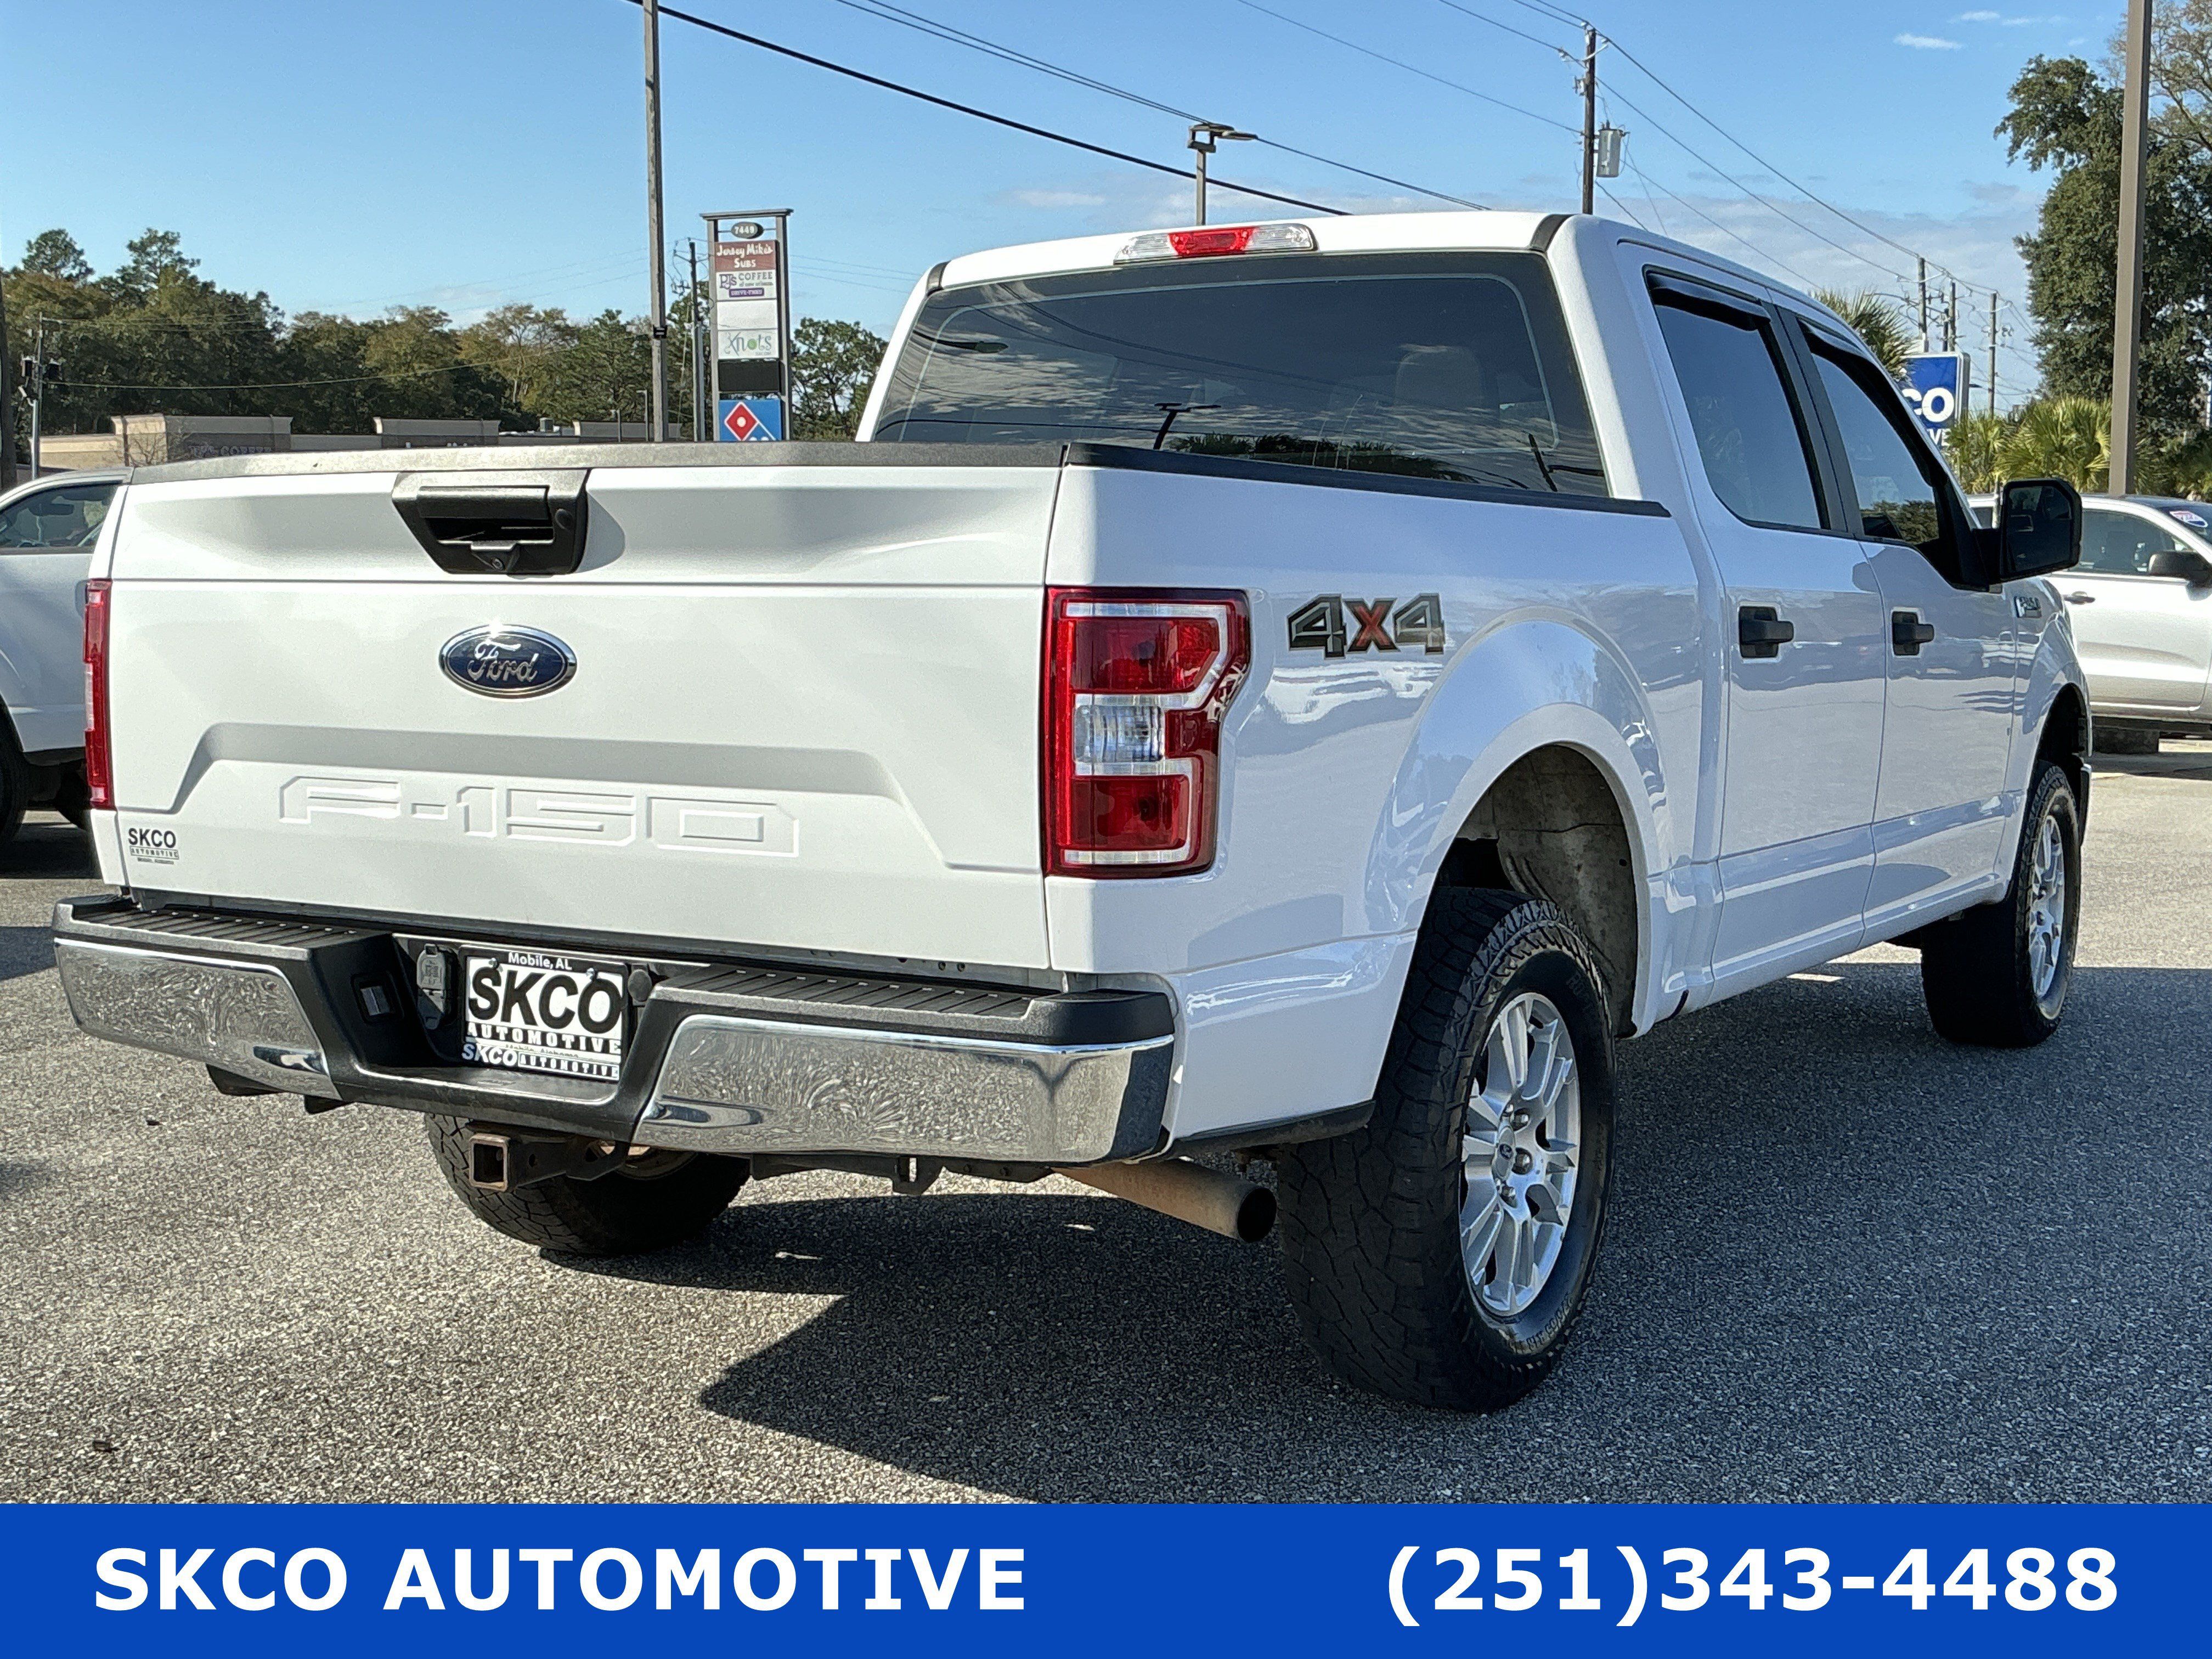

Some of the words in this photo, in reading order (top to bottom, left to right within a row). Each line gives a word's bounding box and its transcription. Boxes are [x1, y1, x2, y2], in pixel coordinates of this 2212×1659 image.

[738, 272, 772, 281] COFFEE
[467, 638, 540, 682] Ford
[279, 775, 799, 857] F-150
[128, 827, 176, 848] SKCO
[508, 952, 554, 970] Mobile,
[555, 957, 573, 970] AL
[469, 966, 623, 1034] SKCO
[467, 1022, 621, 1054] AUTOMOTIVE
[461, 1043, 518, 1066] SKCO
[520, 1054, 619, 1078] AUTOMOTIVE
